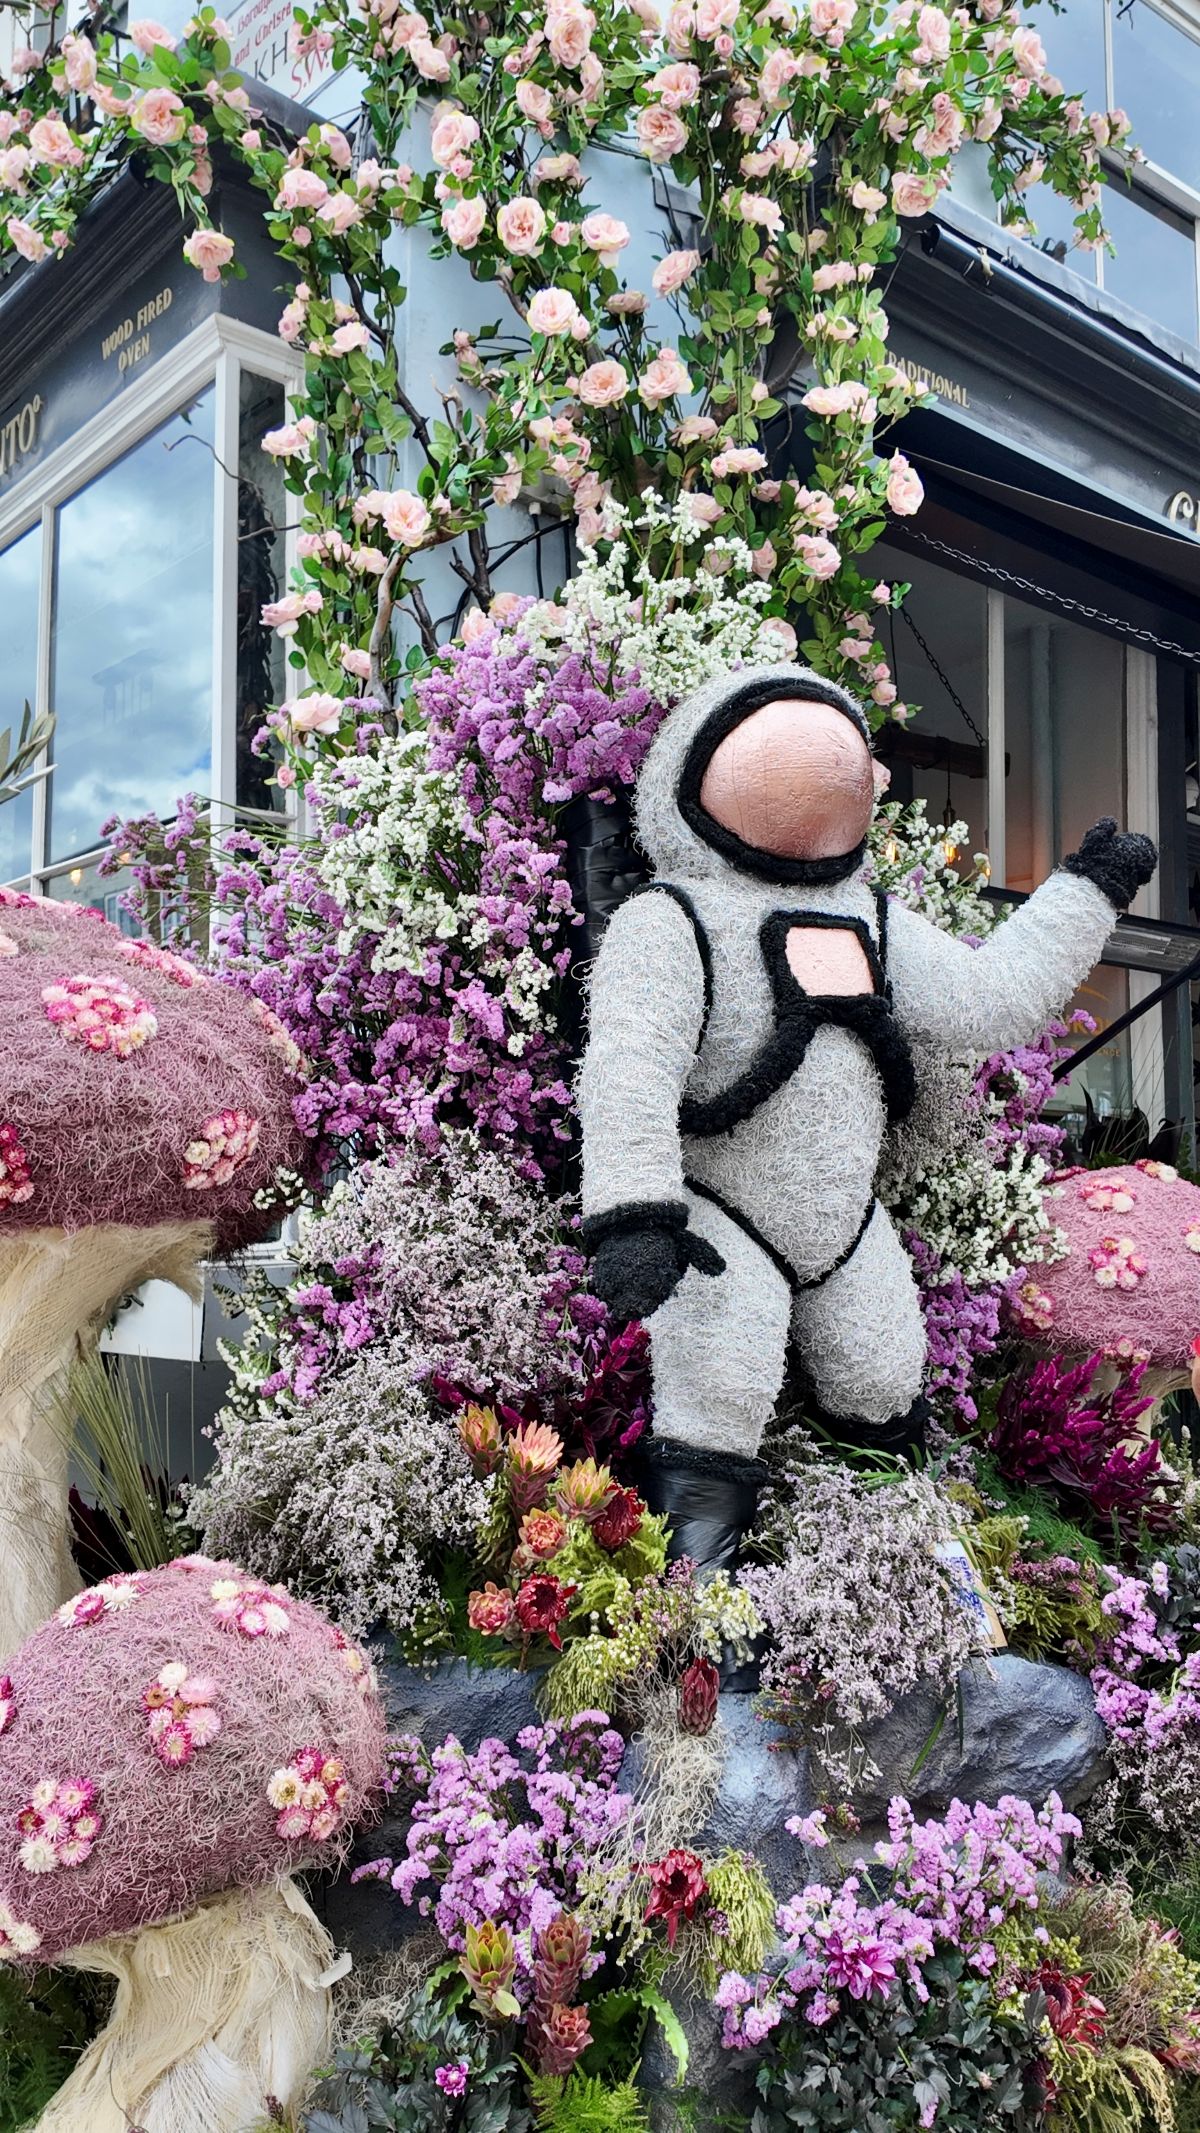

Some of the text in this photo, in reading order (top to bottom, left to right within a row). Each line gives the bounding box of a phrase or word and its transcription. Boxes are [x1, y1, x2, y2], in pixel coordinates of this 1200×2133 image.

[235, 2, 291, 66] and Chelsea
[102, 288, 172, 360] WOOD FIRED
[118, 333, 149, 371] OVEN
[885, 350, 971, 408] RADITIONAL
